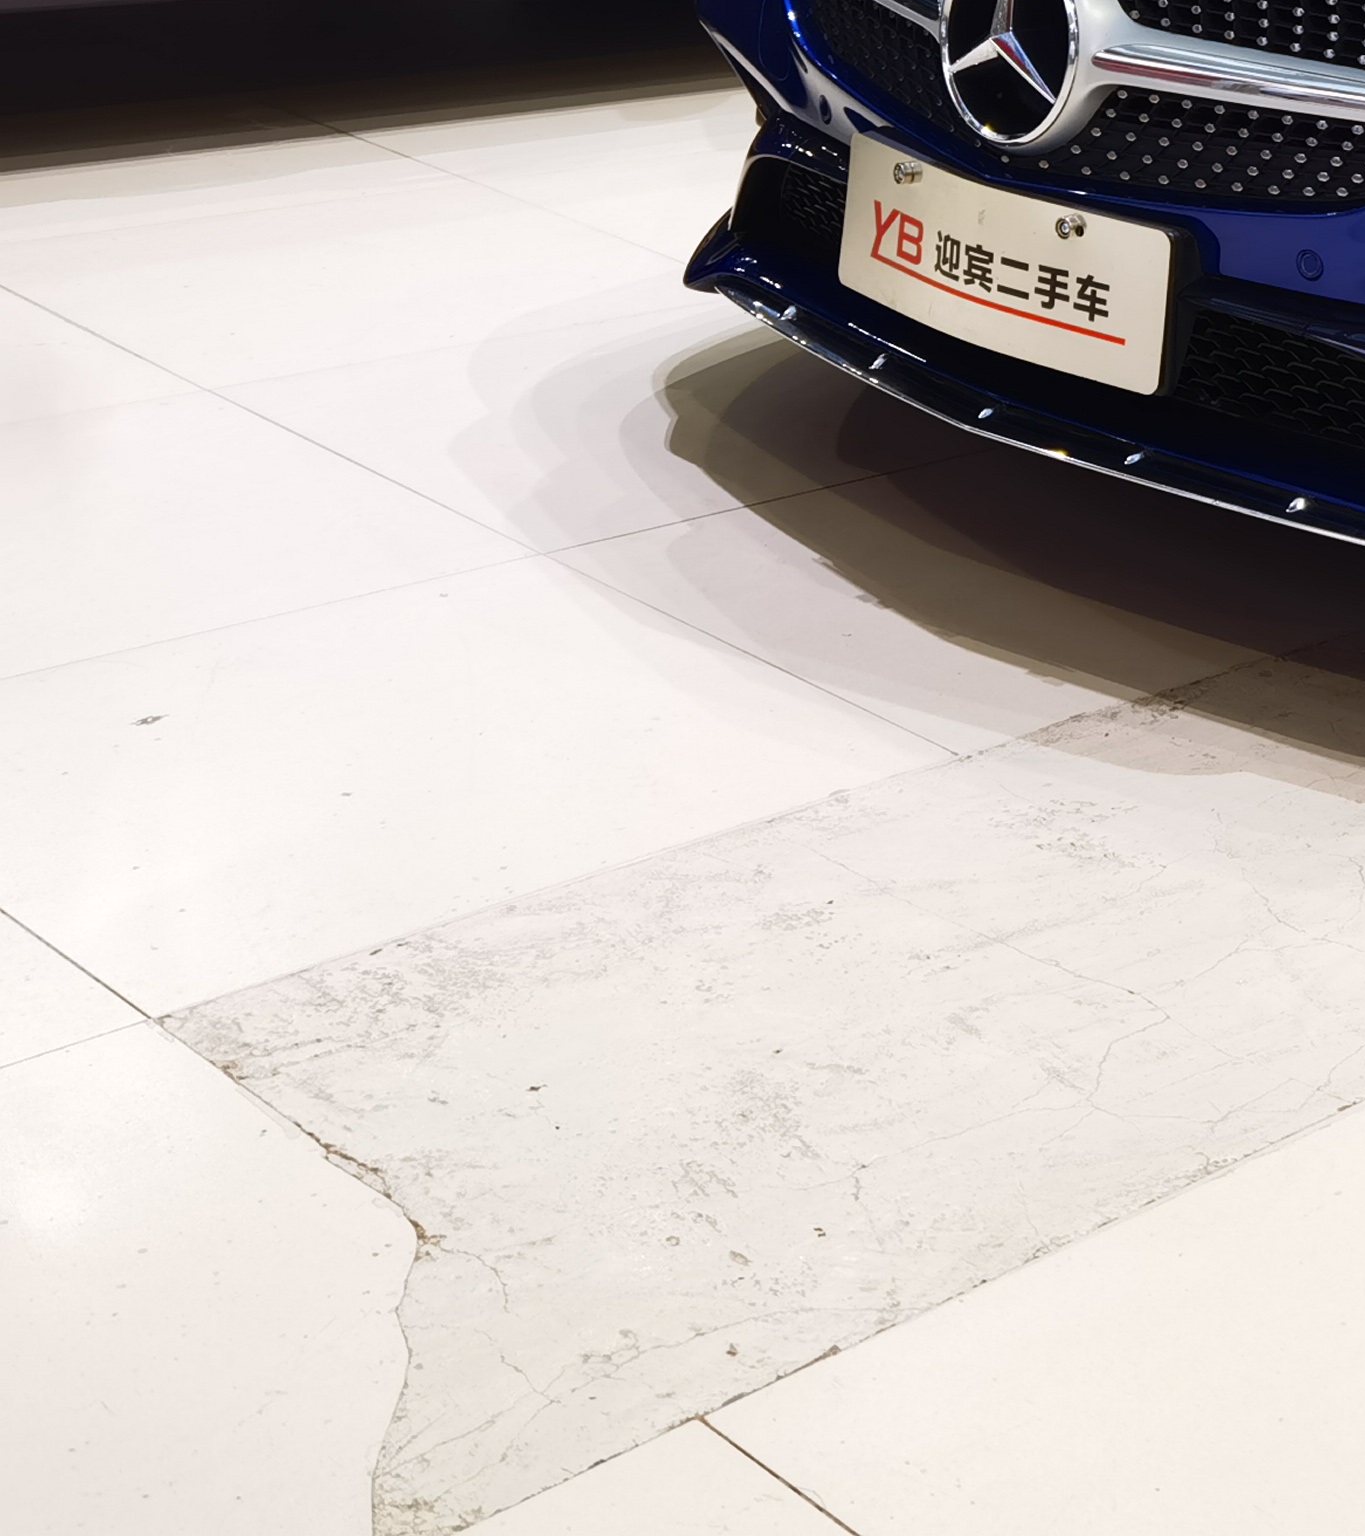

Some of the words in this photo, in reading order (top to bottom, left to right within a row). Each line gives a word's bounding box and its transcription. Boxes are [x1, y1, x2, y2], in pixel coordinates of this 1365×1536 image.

[871, 199, 924, 266] YB
[934, 230, 1111, 323] 迎宾二手车
